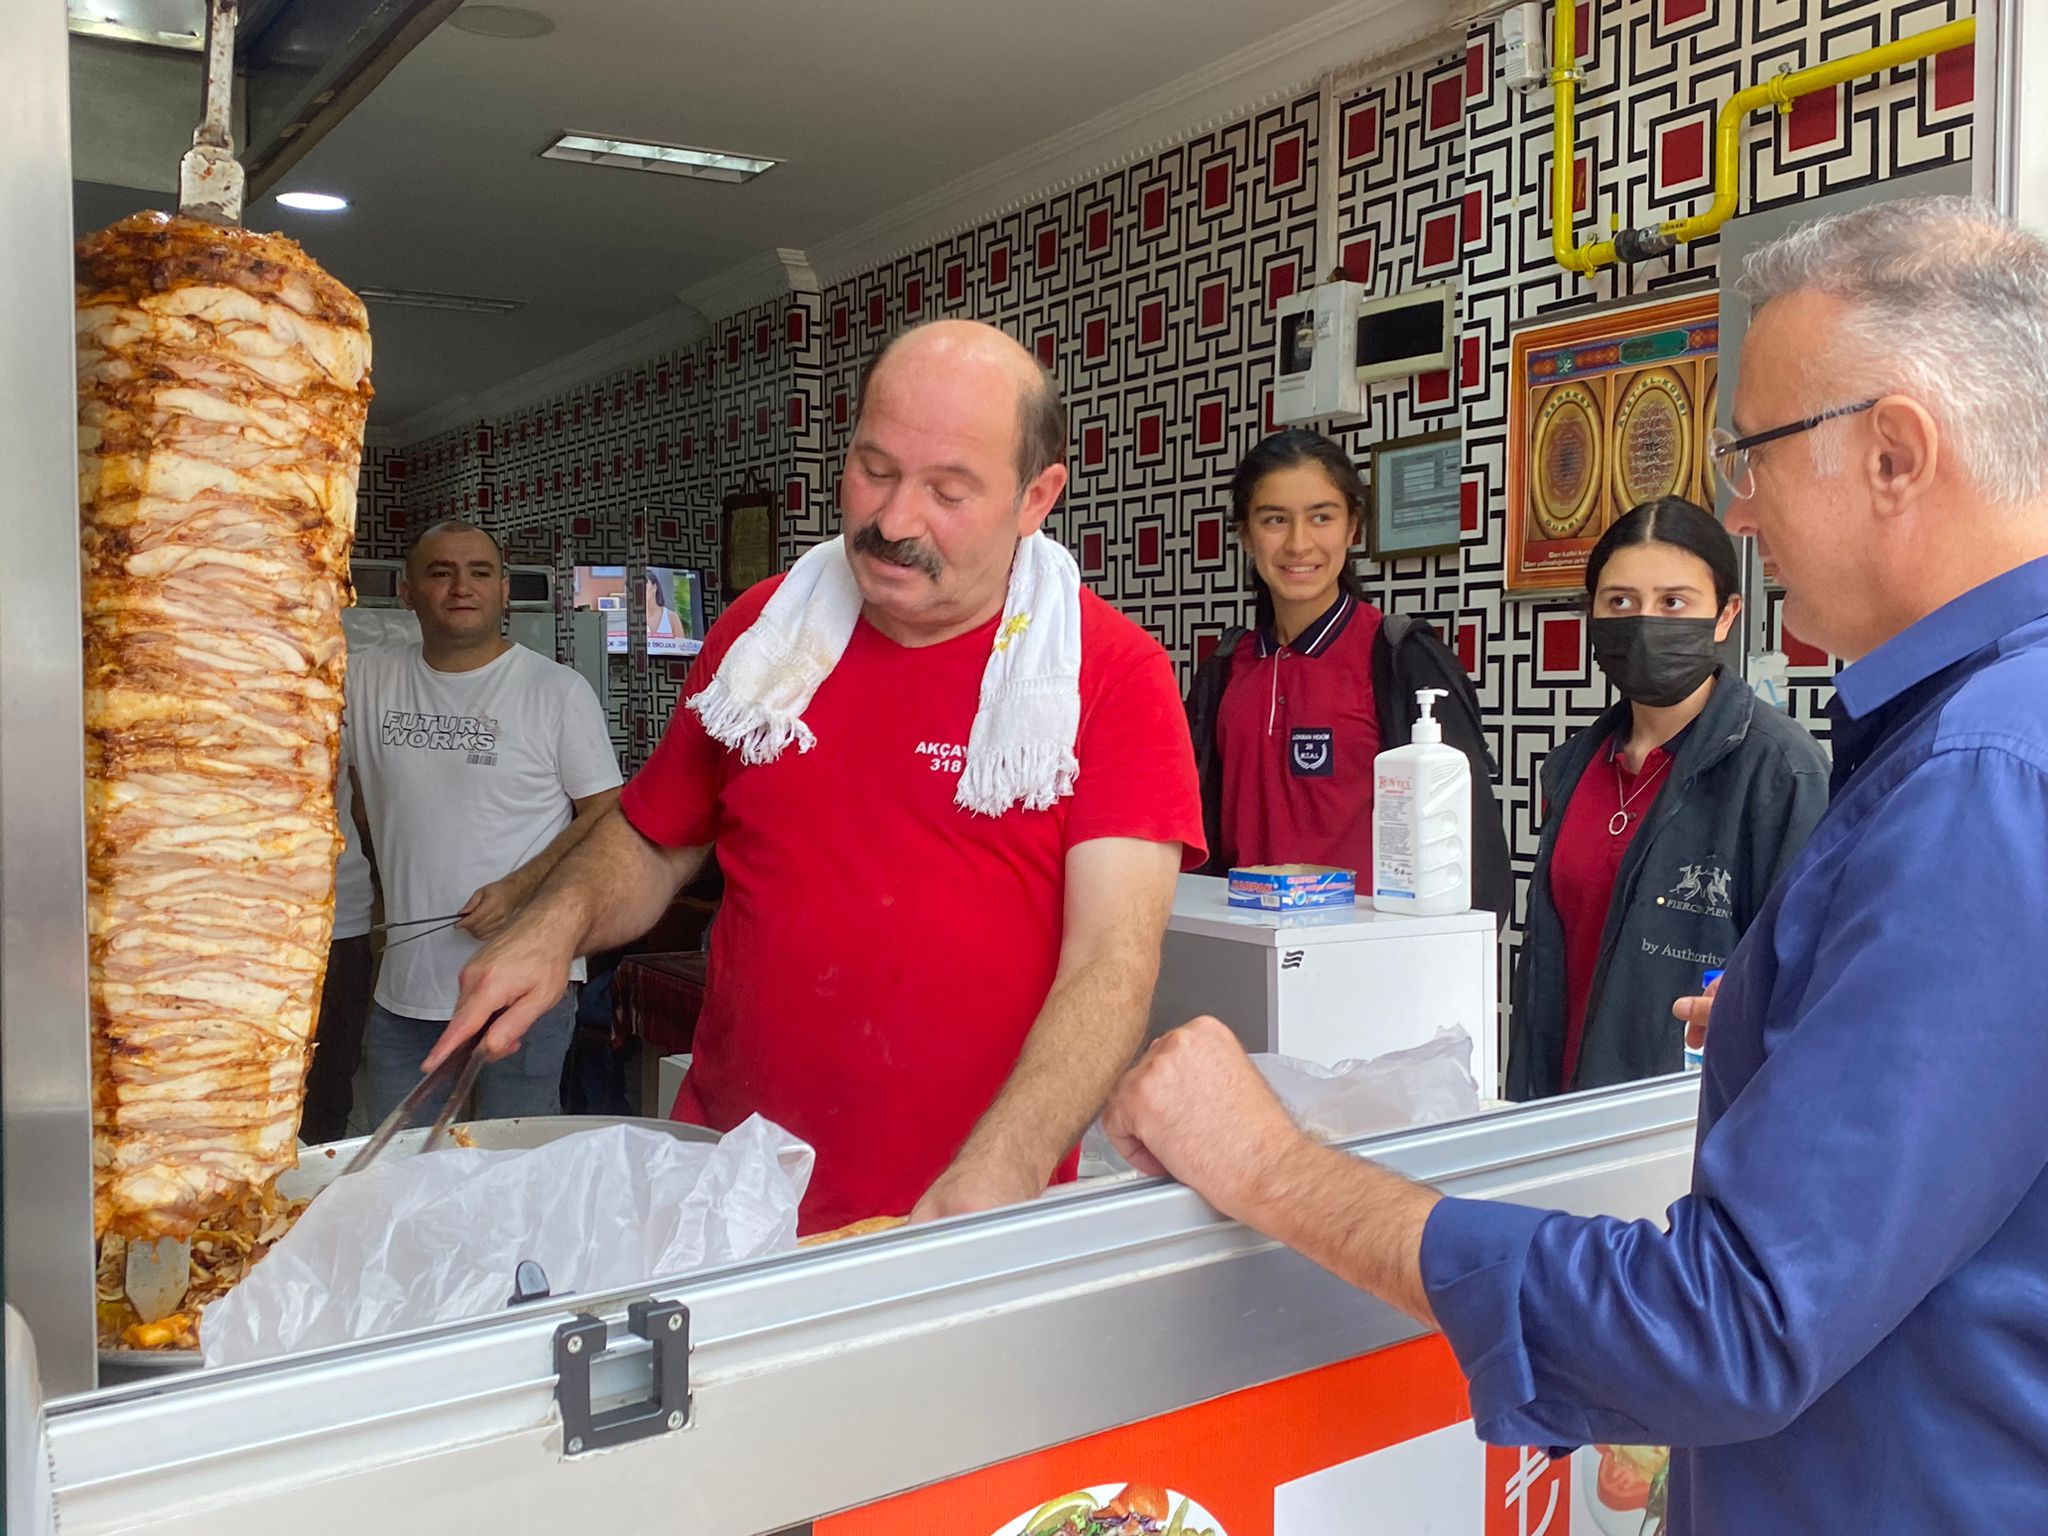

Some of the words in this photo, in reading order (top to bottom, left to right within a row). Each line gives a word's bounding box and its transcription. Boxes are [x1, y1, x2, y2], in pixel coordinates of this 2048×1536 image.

[382, 726, 496, 752] WORKS
[929, 758, 962, 773] 318
[1641, 938, 1659, 955] by
[1661, 943, 1726, 967] Authority
